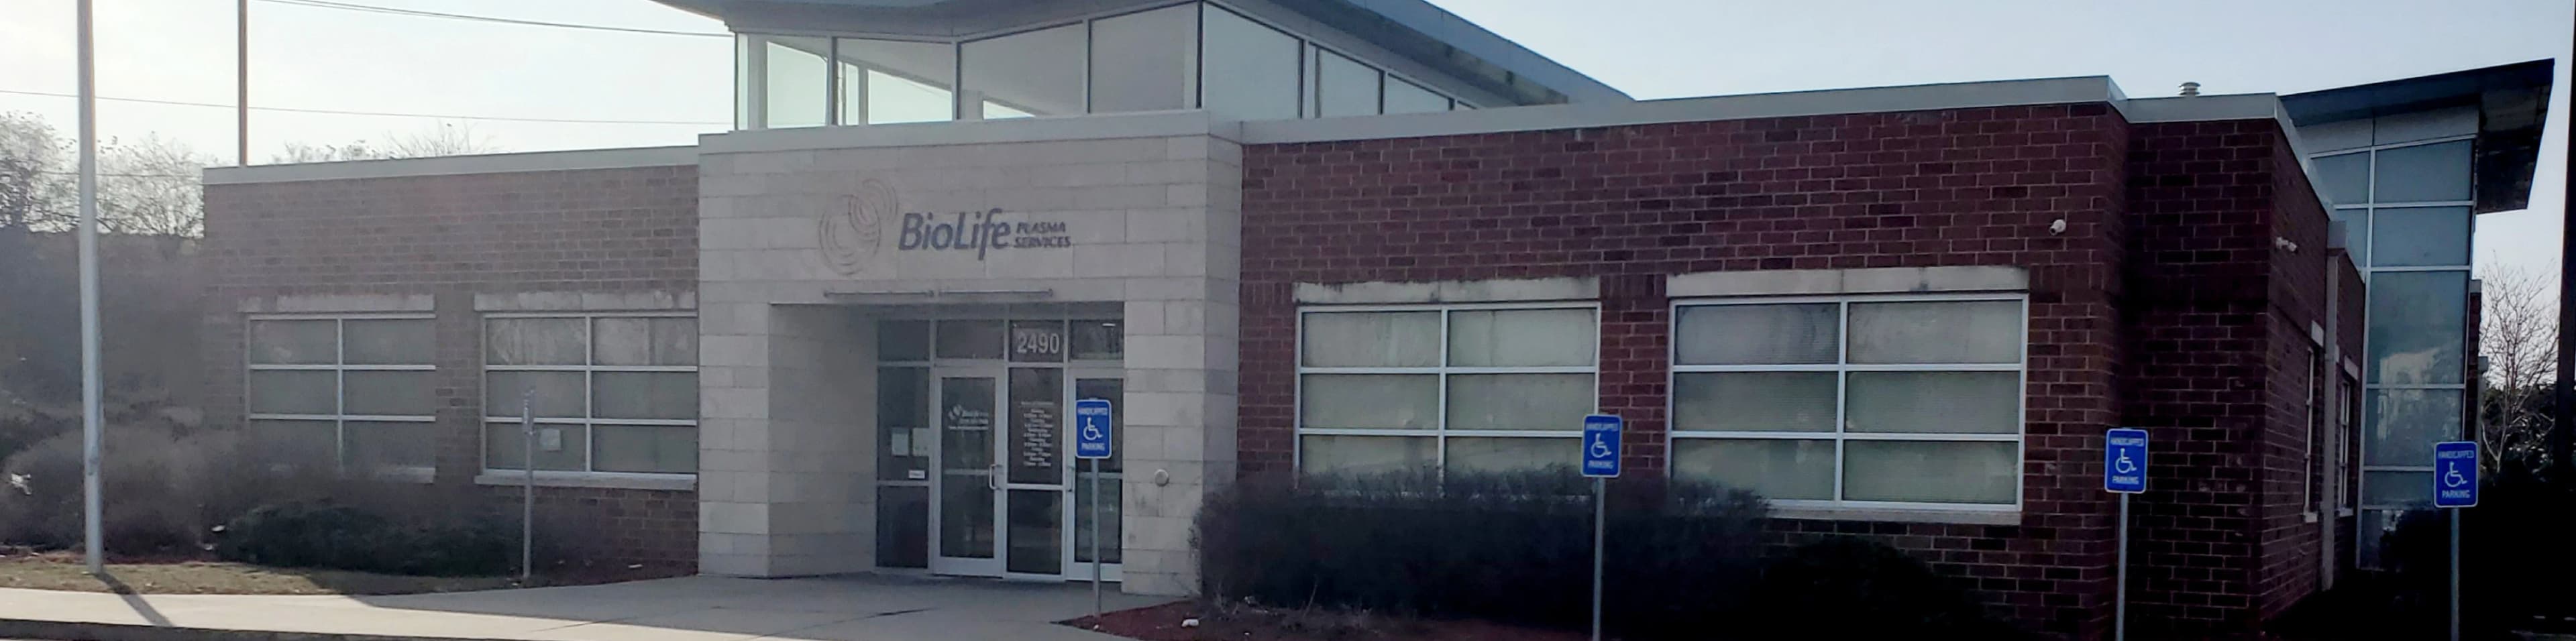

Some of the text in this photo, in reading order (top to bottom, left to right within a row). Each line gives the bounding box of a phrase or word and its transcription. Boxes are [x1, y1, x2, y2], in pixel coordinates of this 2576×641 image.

[898, 208, 1066, 260] BioLife PLASMA
[1014, 236, 1071, 248] SERVICES
[1017, 332, 1059, 354] 2490
[2112, 475, 2139, 485] PARKING
[2442, 489, 2470, 498] PARKING
